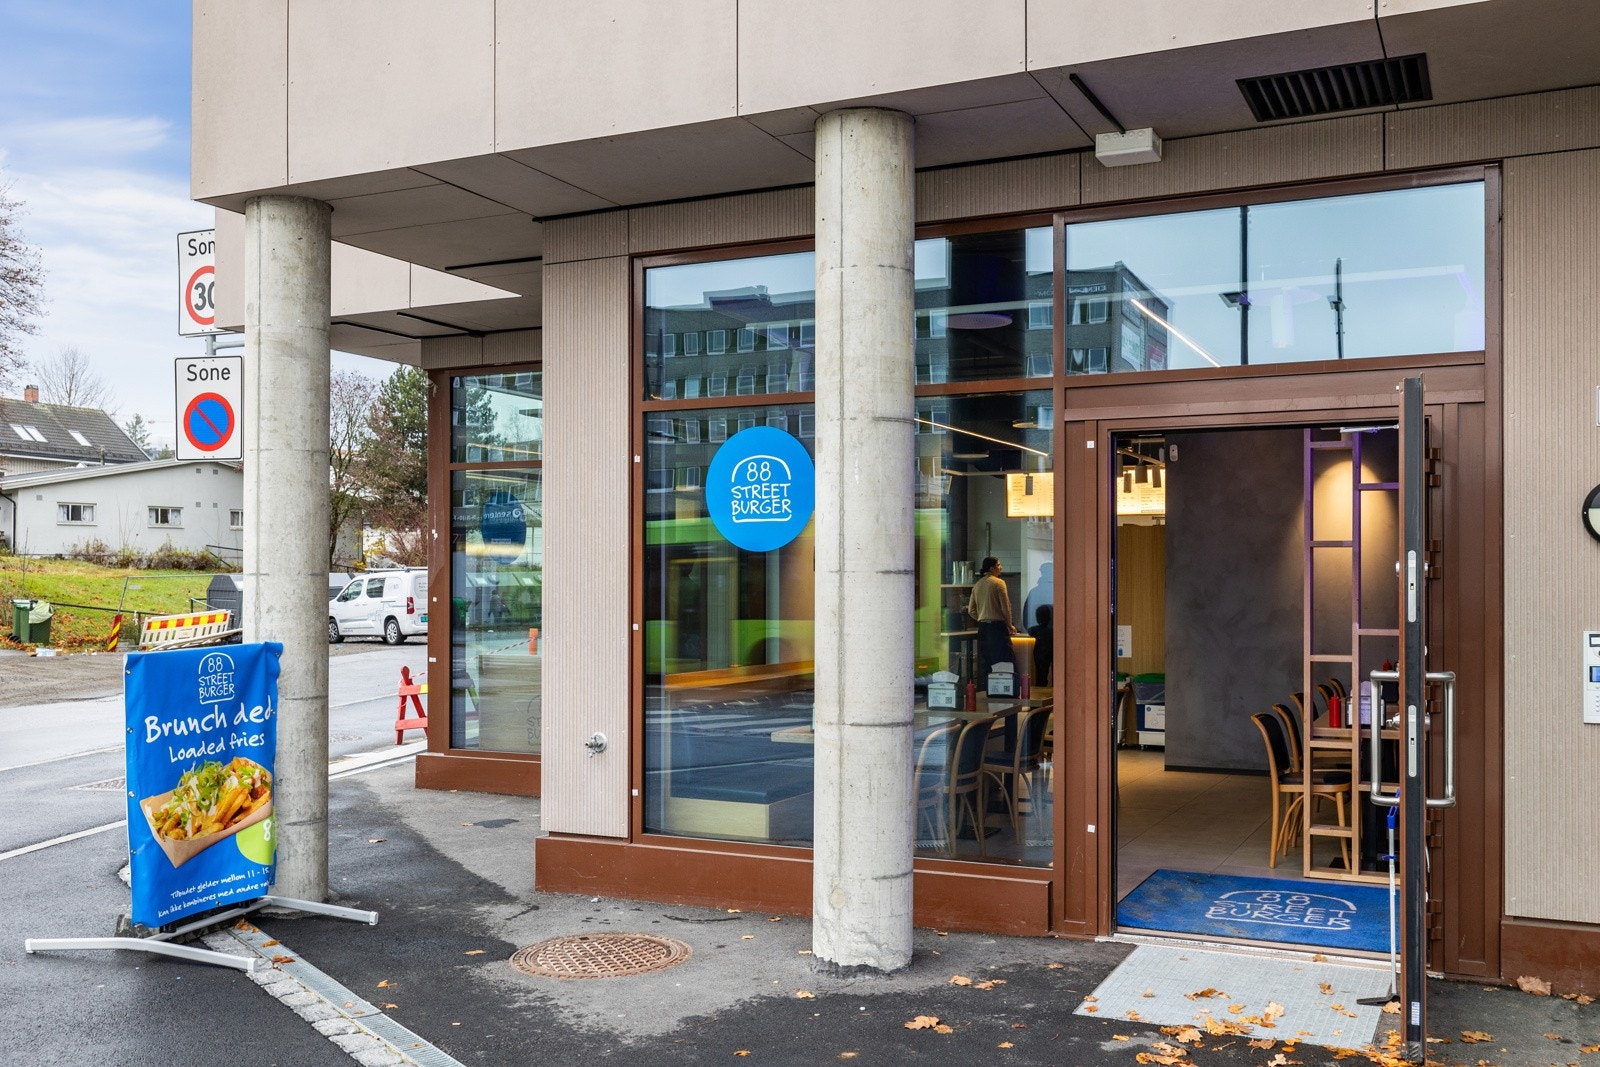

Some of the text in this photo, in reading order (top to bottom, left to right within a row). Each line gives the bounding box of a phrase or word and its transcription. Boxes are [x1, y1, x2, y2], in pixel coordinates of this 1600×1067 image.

[188, 238, 216, 257] Son
[187, 364, 231, 382] Sone
[747, 461, 771, 482] 88
[731, 483, 791, 499] STREET
[731, 498, 792, 515] BURGER
[208, 657, 223, 673] 88
[199, 671, 235, 686] STREET
[199, 683, 235, 699] BURGER
[145, 704, 227, 743] Brunch
[168, 731, 265, 763] Loaded fries
[197, 880, 219, 893] gjelder
[220, 873, 246, 884] mellom
[170, 903, 182, 913] ikke
[218, 888, 235, 897] med
[236, 883, 260, 894] andre
[1256, 892, 1311, 906] 88
[1207, 906, 1351, 928] BURGER
[1213, 900, 1357, 918] STREET
